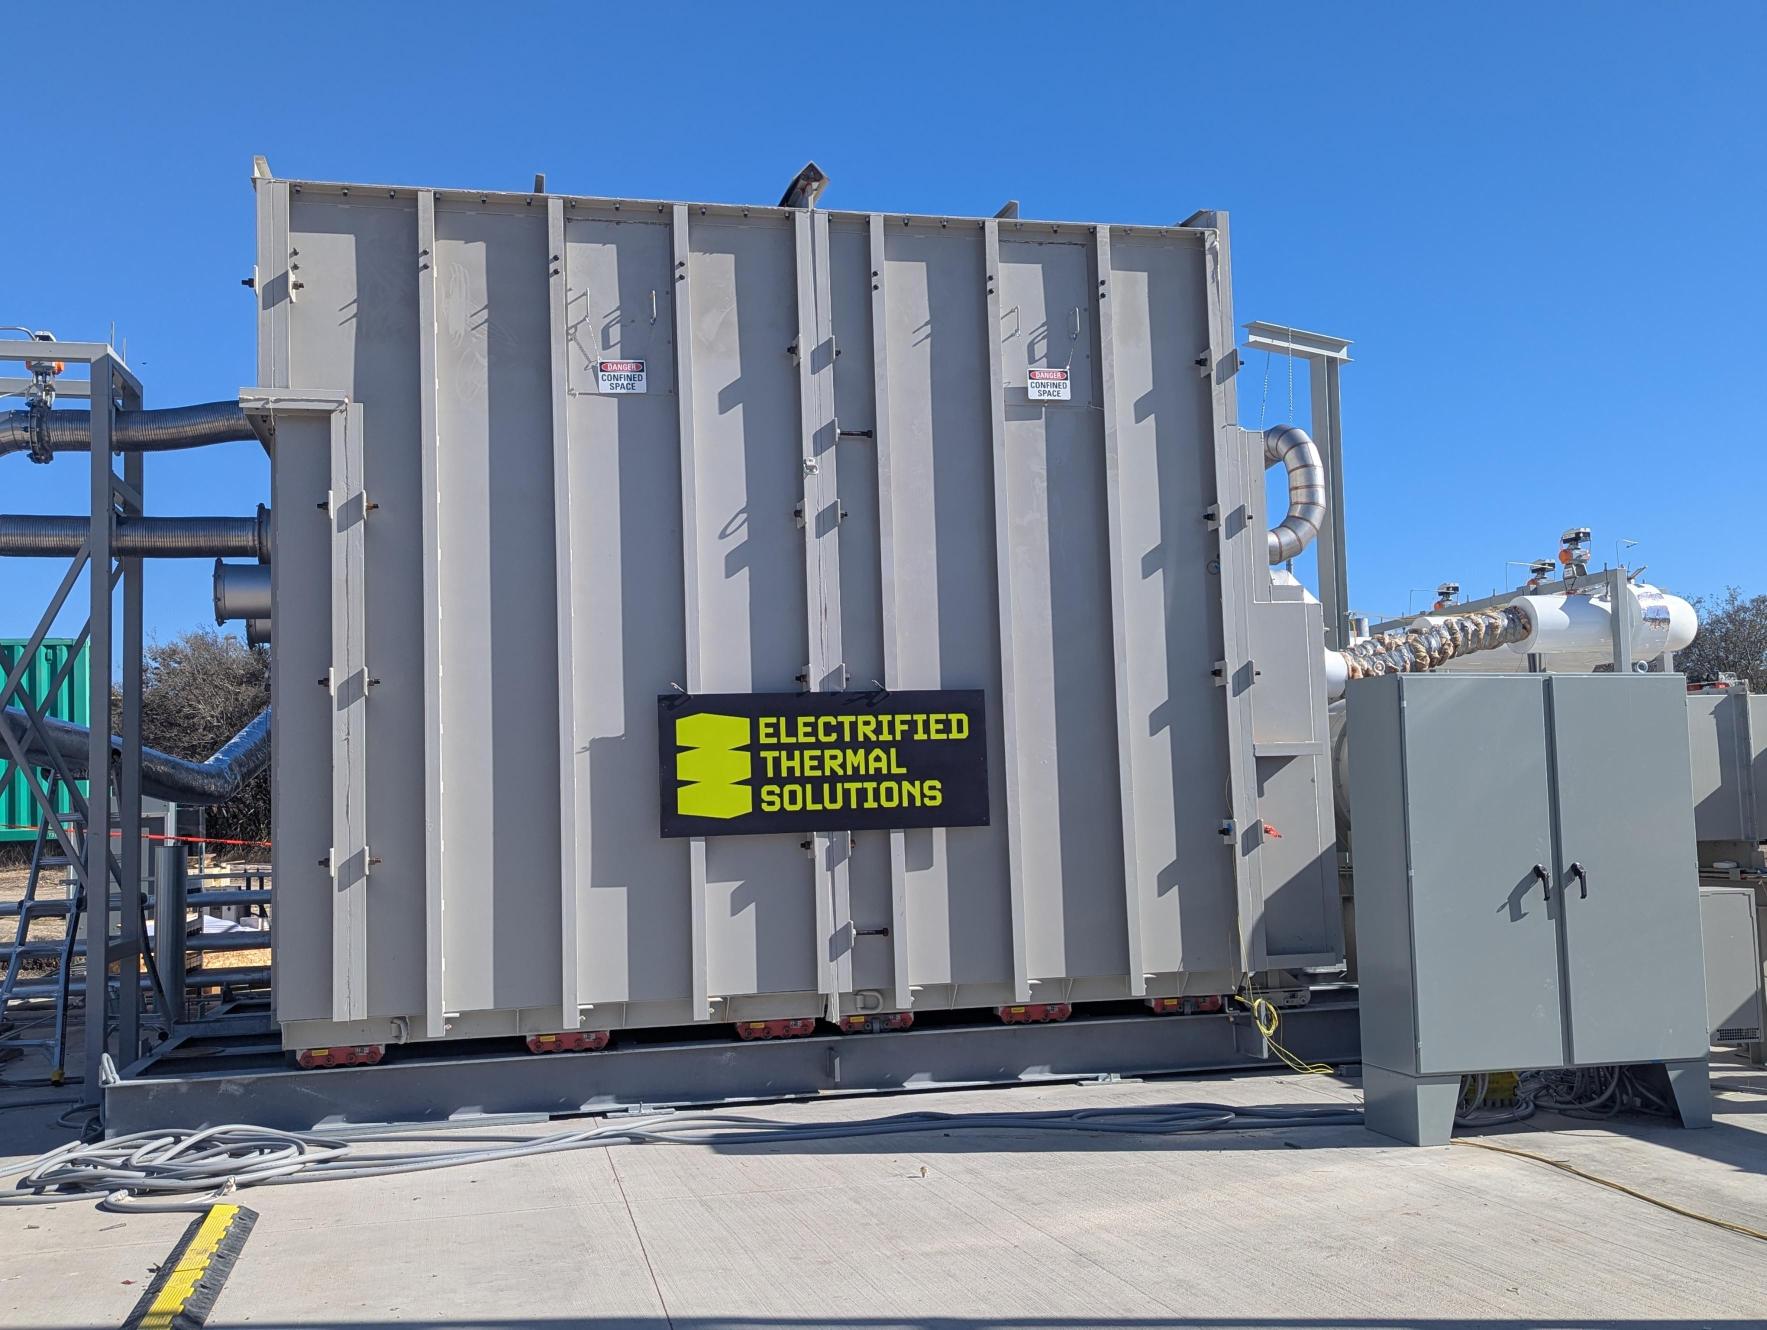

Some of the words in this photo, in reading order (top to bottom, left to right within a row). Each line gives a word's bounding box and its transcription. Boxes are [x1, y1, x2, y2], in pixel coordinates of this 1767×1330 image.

[607, 363, 636, 371] DANGER
[609, 382, 636, 390] SPACE
[1037, 389, 1061, 397] SPACE
[759, 714, 968, 743] ELECTRIFIED
[760, 748, 906, 777] THERMAL
[761, 780, 942, 811] SOLUTIONS
